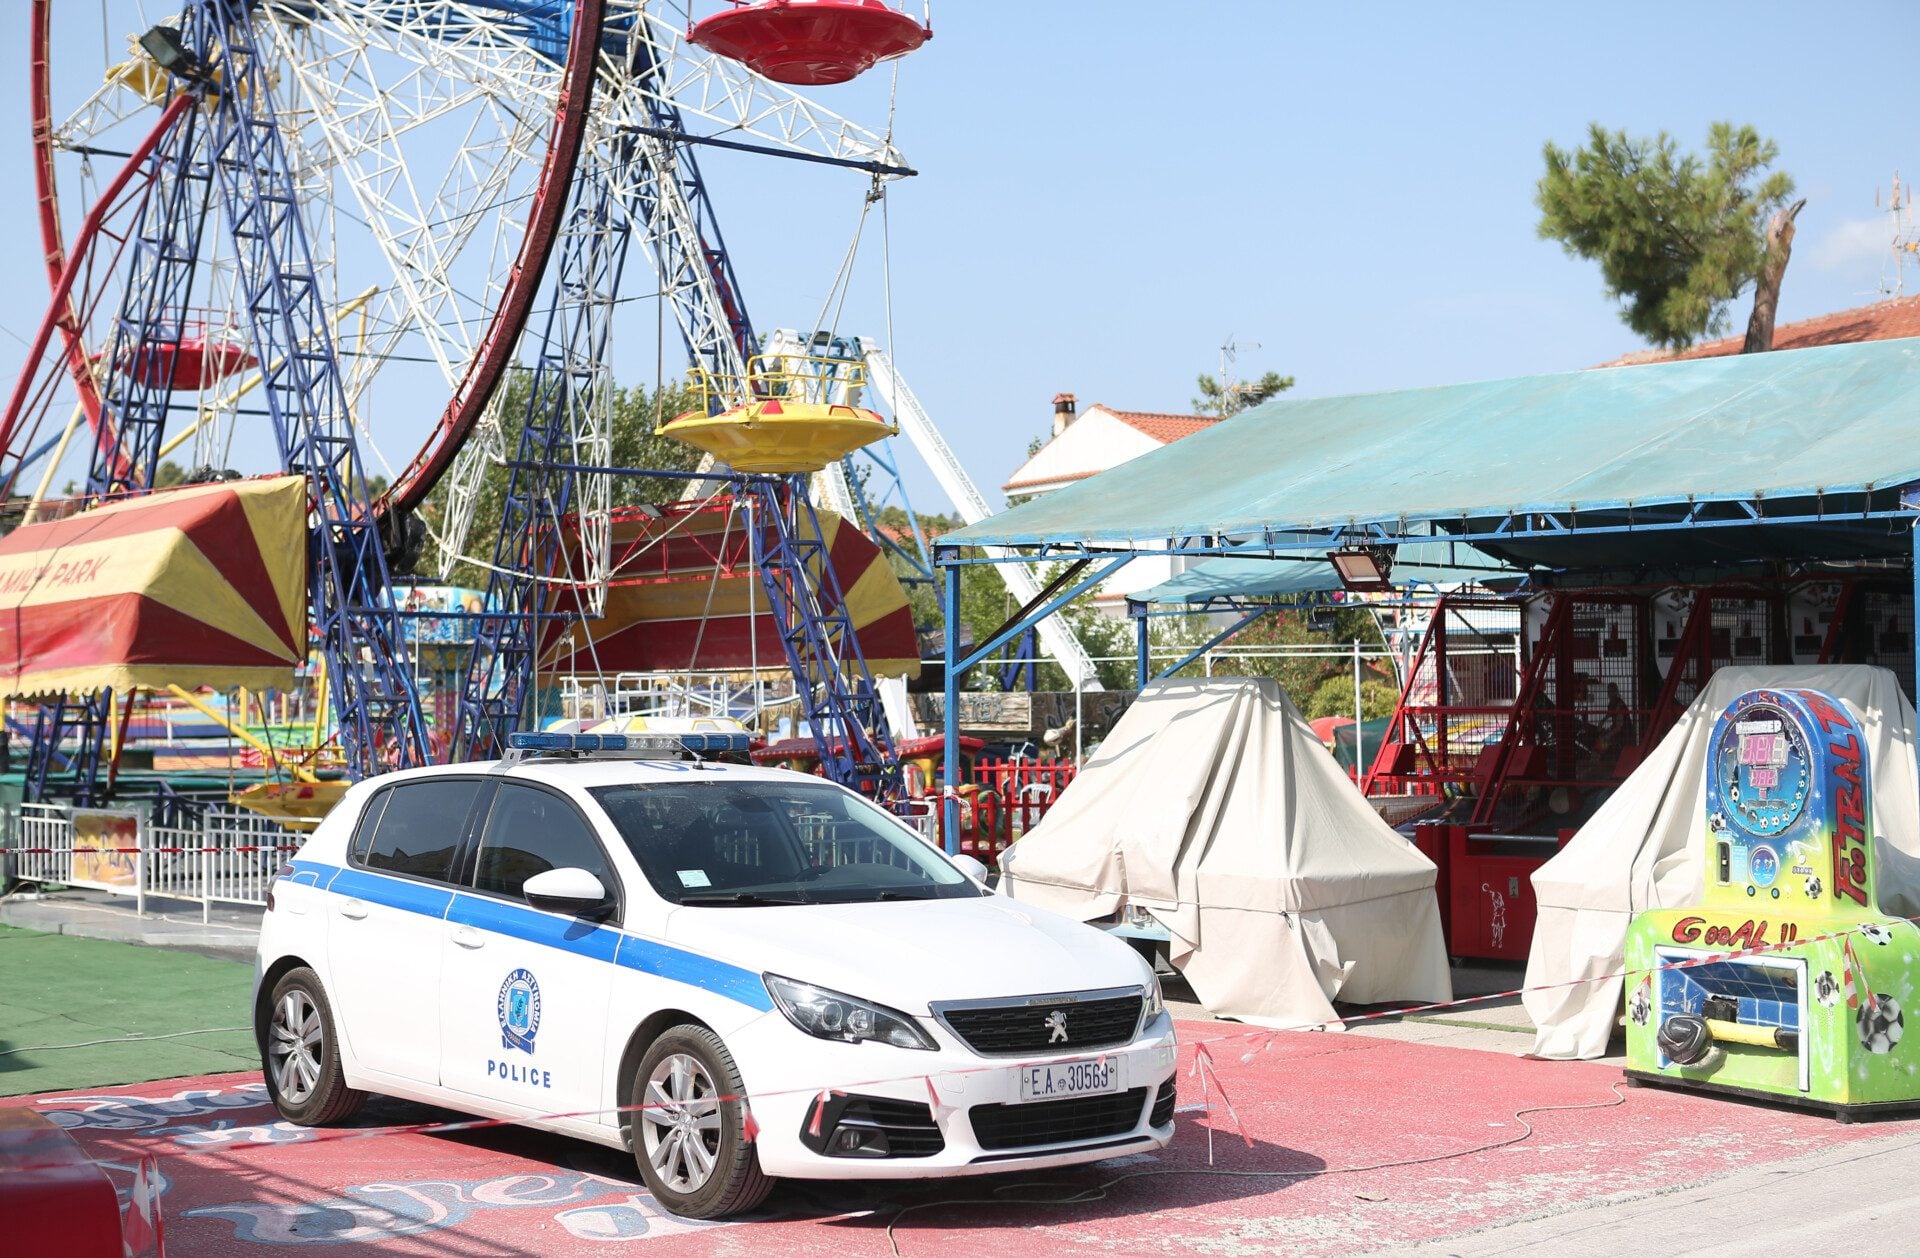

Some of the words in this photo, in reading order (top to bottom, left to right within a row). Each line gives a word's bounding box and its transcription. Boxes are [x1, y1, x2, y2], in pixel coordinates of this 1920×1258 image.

[46, 555, 110, 588] PARK
[488, 1060, 551, 1089] POLICE
[1068, 1062, 1109, 1092] 30569
